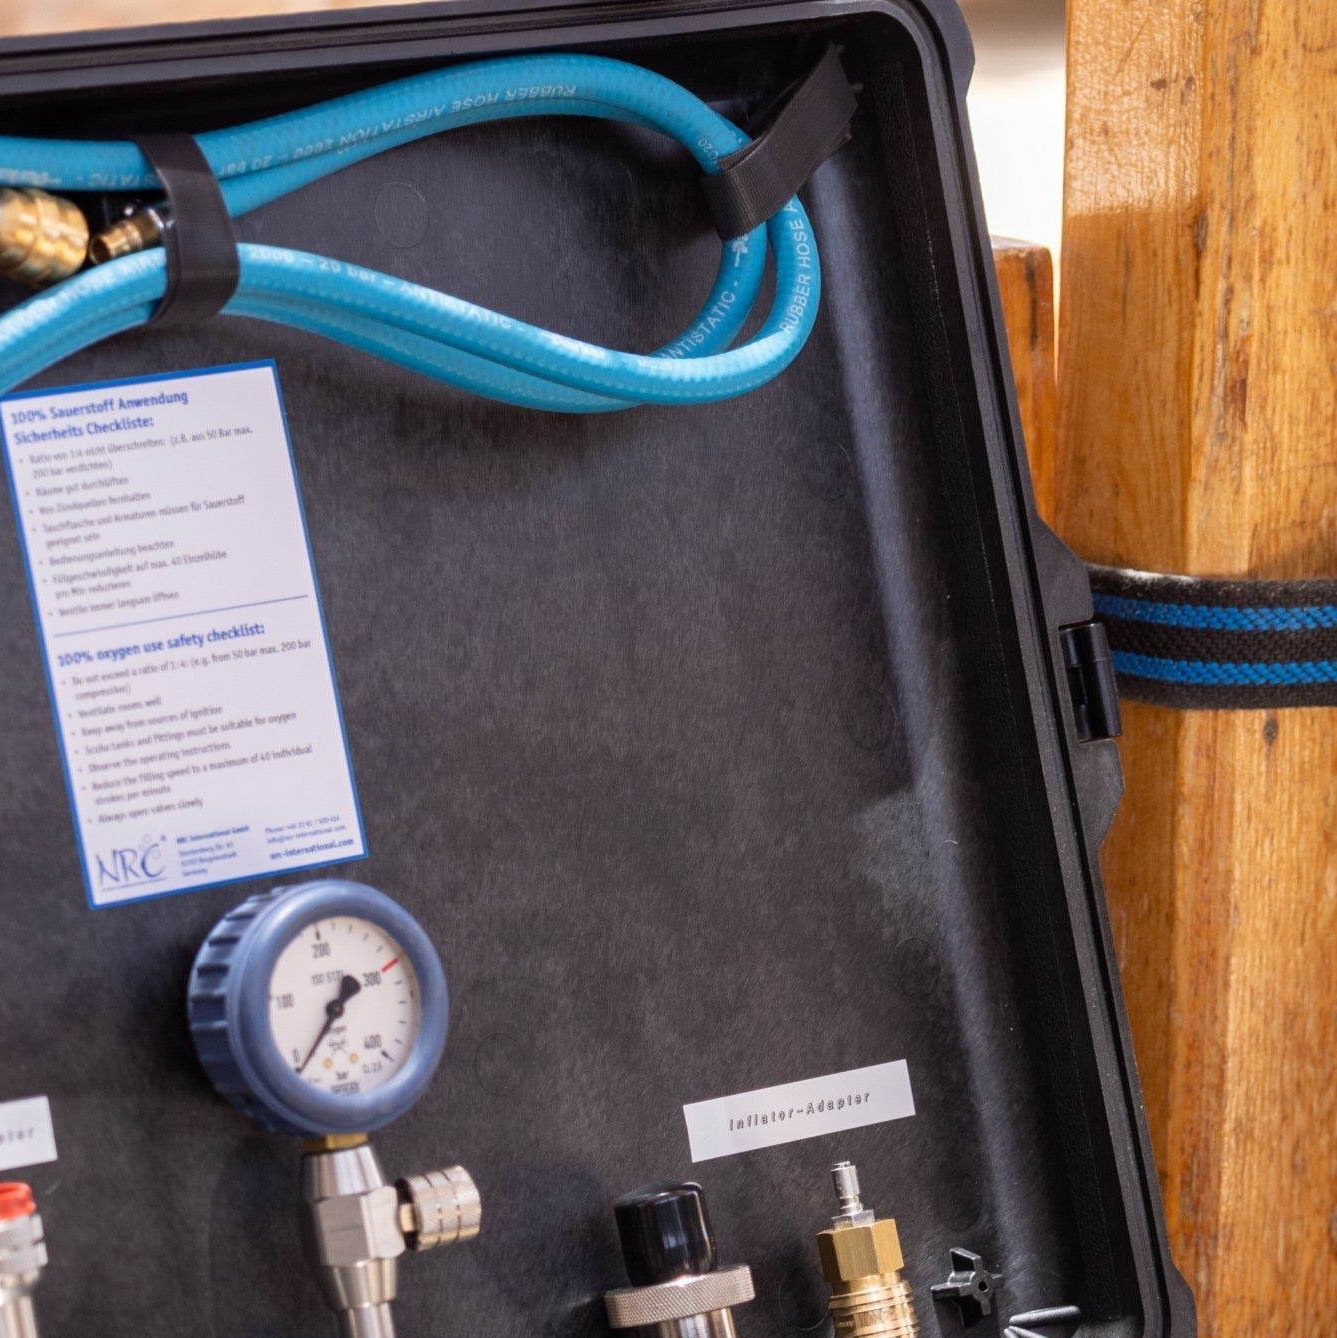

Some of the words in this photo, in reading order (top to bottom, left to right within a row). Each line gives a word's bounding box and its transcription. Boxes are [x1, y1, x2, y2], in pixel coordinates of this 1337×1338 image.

[450, 92, 499, 113] HOSE
[504, 84, 577, 102] RUBBER
[339, 103, 447, 149] AIRSTATION
[790, 218, 812, 269] HOSE
[318, 258, 342, 274] 20
[348, 264, 377, 283] bar
[778, 273, 812, 335] RUBBER
[10, 409, 46, 425] 100%
[49, 398, 114, 419] Sauerstoff
[118, 392, 188, 409] Anwendung
[14, 425, 84, 445] Sicherheits
[86, 417, 153, 435] Checkliste:
[191, 433, 205, 442] aus
[205, 429, 218, 440] 50
[217, 428, 232, 438] Bar
[233, 426, 253, 435] max.
[189, 501, 202, 511] für
[203, 494, 244, 510] Sauerstoff
[171, 556, 182, 566] 40
[57, 650, 94, 667] 100%
[96, 644, 140, 661] oxygen
[142, 640, 164, 653] use
[167, 633, 204, 649] safety
[206, 623, 264, 642] checklist:
[159, 660, 169, 671] of
[211, 653, 231, 662] from
[231, 649, 244, 660] 50
[243, 648, 257, 658] bar
[259, 646, 279, 655] max.
[280, 640, 297, 652] 200
[297, 640, 311, 649] bar
[179, 709, 189, 720] of
[188, 706, 223, 720] ignition
[208, 725, 219, 734] be
[220, 718, 253, 732] suitable
[254, 716, 266, 726] for
[268, 712, 297, 723] oxygen
[180, 742, 231, 756] instructions
[208, 757, 249, 770] maximum
[249, 752, 259, 764] of
[259, 751, 271, 761] 40
[272, 744, 312, 759] individual
[177, 797, 203, 809] slowly
[96, 843, 162, 884] NRC
[312, 943, 330, 958] 200
[363, 972, 381, 986] 300
[276, 994, 293, 1009] 100
[364, 1035, 382, 1050] 400
[336, 1070, 349, 1081] bar
[729, 1091, 870, 1132] Inflator-Adapter
